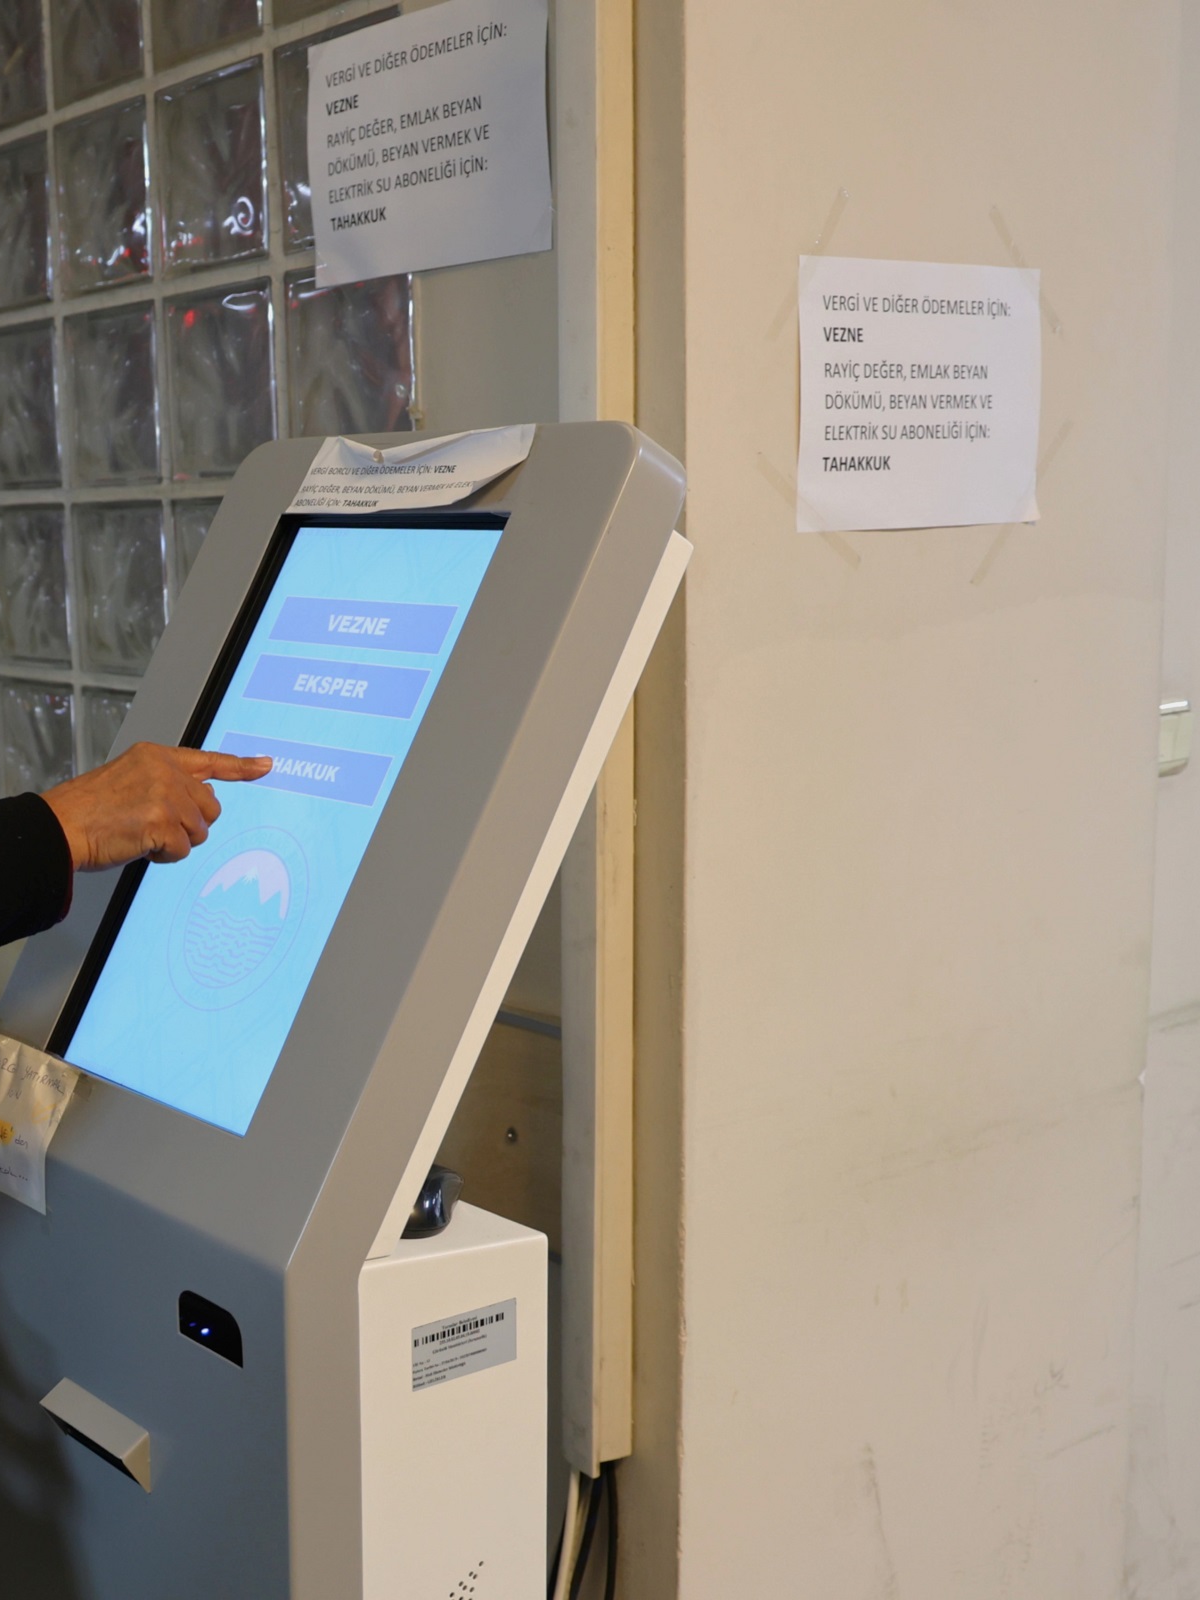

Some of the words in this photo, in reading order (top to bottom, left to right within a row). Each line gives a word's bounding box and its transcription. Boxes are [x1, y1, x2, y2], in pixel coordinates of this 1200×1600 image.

[326, 62, 356, 88] VERGİ
[358, 60, 371, 78] VE
[374, 49, 407, 74] DİĞER
[410, 30, 473, 62] ÖDEMELER
[477, 22, 507, 48] İÇİN:
[326, 94, 359, 116] VEZNE
[327, 125, 356, 149] RAYİÇ
[358, 117, 397, 139] DEĞER,
[400, 106, 439, 130] EMLAK
[443, 95, 482, 119] BEYAN
[328, 149, 379, 176] DÖKÜMÜ,
[382, 142, 419, 164] BEYAN
[422, 130, 472, 154] VERMEK
[474, 124, 490, 141] VE
[329, 182, 374, 204] ELEKTRİK
[376, 177, 391, 194] SU
[394, 161, 456, 189] ABONELİĞİ
[460, 156, 488, 178] İÇİN:
[330, 206, 387, 232] TAHAKKUK
[823, 293, 860, 312] VERGİ
[864, 297, 878, 312] VE
[882, 294, 918, 314] DİĞER
[922, 295, 985, 316] ÖDEMELER
[987, 298, 1012, 320] İÇİN:
[823, 327, 864, 343] VEZNE
[824, 359, 860, 382] RAYİÇ
[864, 360, 907, 382] DEĞER,
[910, 364, 950, 380] EMLAK
[953, 364, 988, 380] BEYAN
[825, 391, 885, 412] DÖKÜMÜ,
[889, 395, 927, 410] BEYAN
[931, 395, 978, 410] VERMEK
[980, 395, 993, 410] VE
[825, 422, 879, 440] ELEKTRİK
[881, 425, 896, 440] SU
[900, 421, 963, 440] ABONELİĞİ
[965, 422, 990, 443] İÇİN:
[360, 465, 379, 475] DİĞER
[380, 465, 415, 474] ÖDEMELER
[415, 464, 433, 476] İÇİN:
[434, 465, 457, 473] VEZNE
[823, 456, 891, 472] TAHAKKUK
[328, 614, 391, 636] VEZNE
[293, 674, 368, 699] EKSPER
[256, 752, 340, 782] HAKKUK
